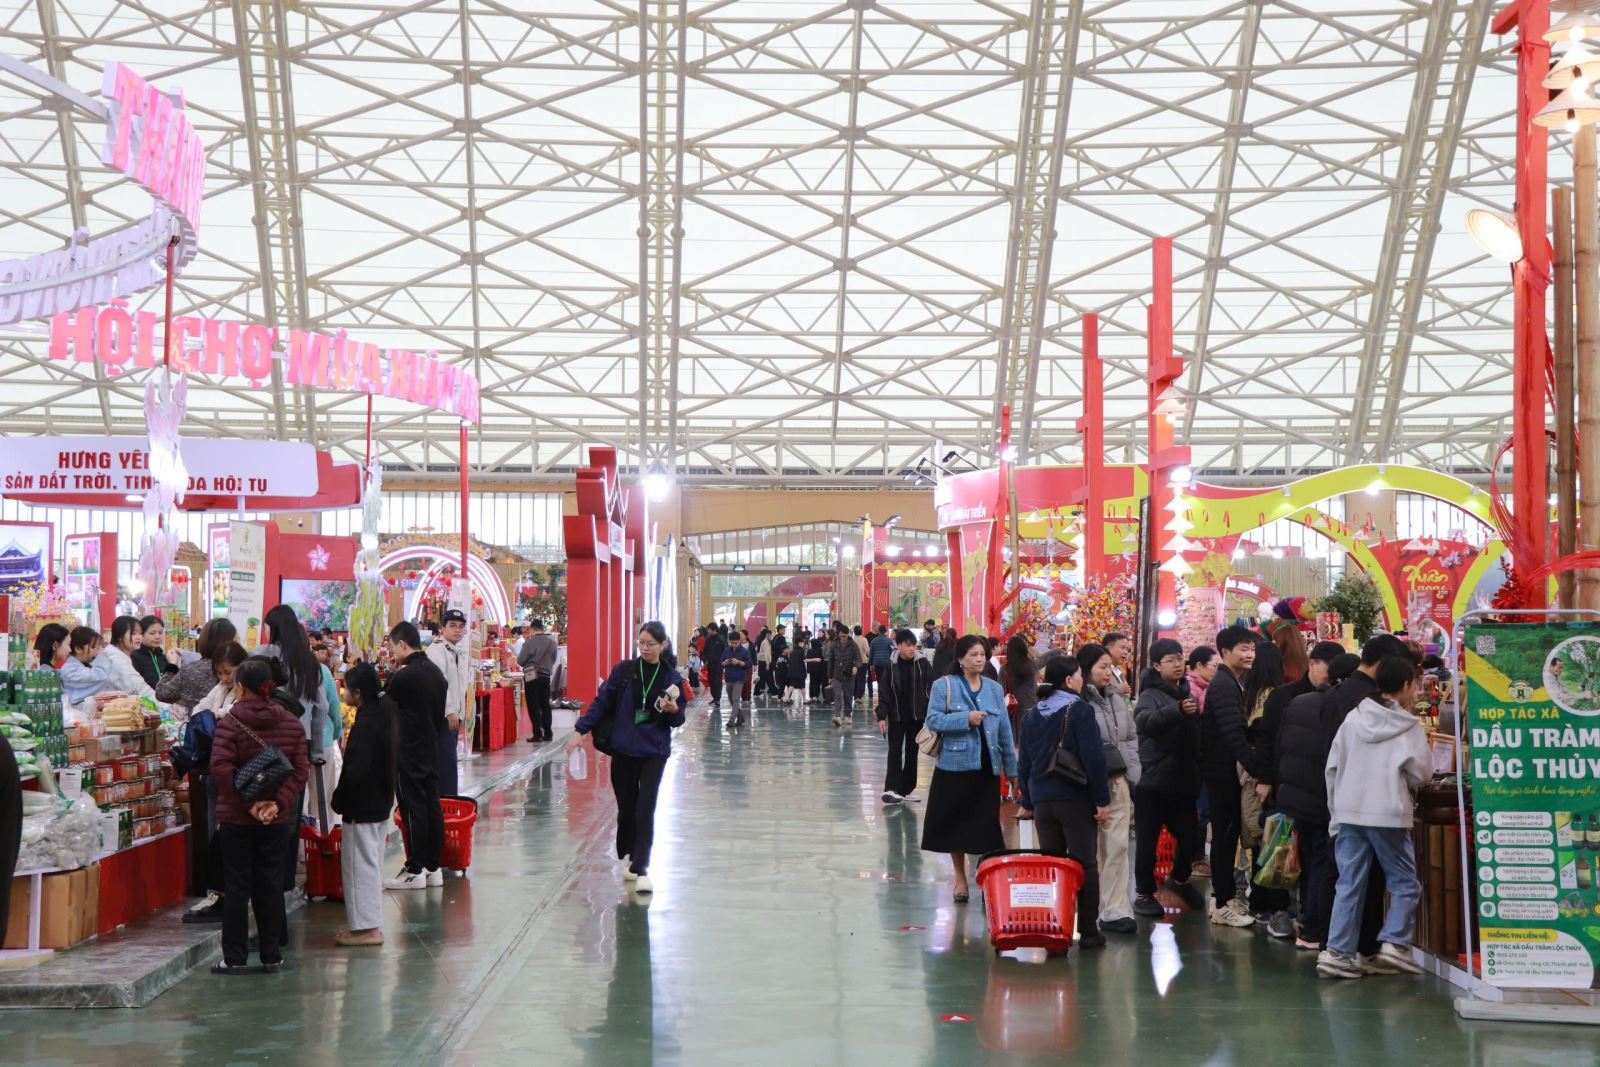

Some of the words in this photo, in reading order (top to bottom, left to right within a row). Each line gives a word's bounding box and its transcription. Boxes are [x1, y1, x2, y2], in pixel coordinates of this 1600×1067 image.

[48, 298, 157, 375] HỘI
[171, 315, 279, 388] CHỢ
[287, 327, 384, 393] MÙA
[58, 450, 111, 469] HƯNG
[119, 449, 150, 469] YÊ
[5, 471, 33, 489] SẢN
[39, 470, 67, 489] ĐẤT
[213, 475, 242, 494] HỘI
[248, 478, 267, 494] TỤ
[1510, 707, 1536, 719] TÁC
[1541, 707, 1560, 719] XÃ
[1472, 721, 1522, 748] DẦU
[1529, 723, 1600, 748] TRÀM
[1474, 753, 1524, 783] LỘC
[1532, 752, 1600, 779] THỦY
